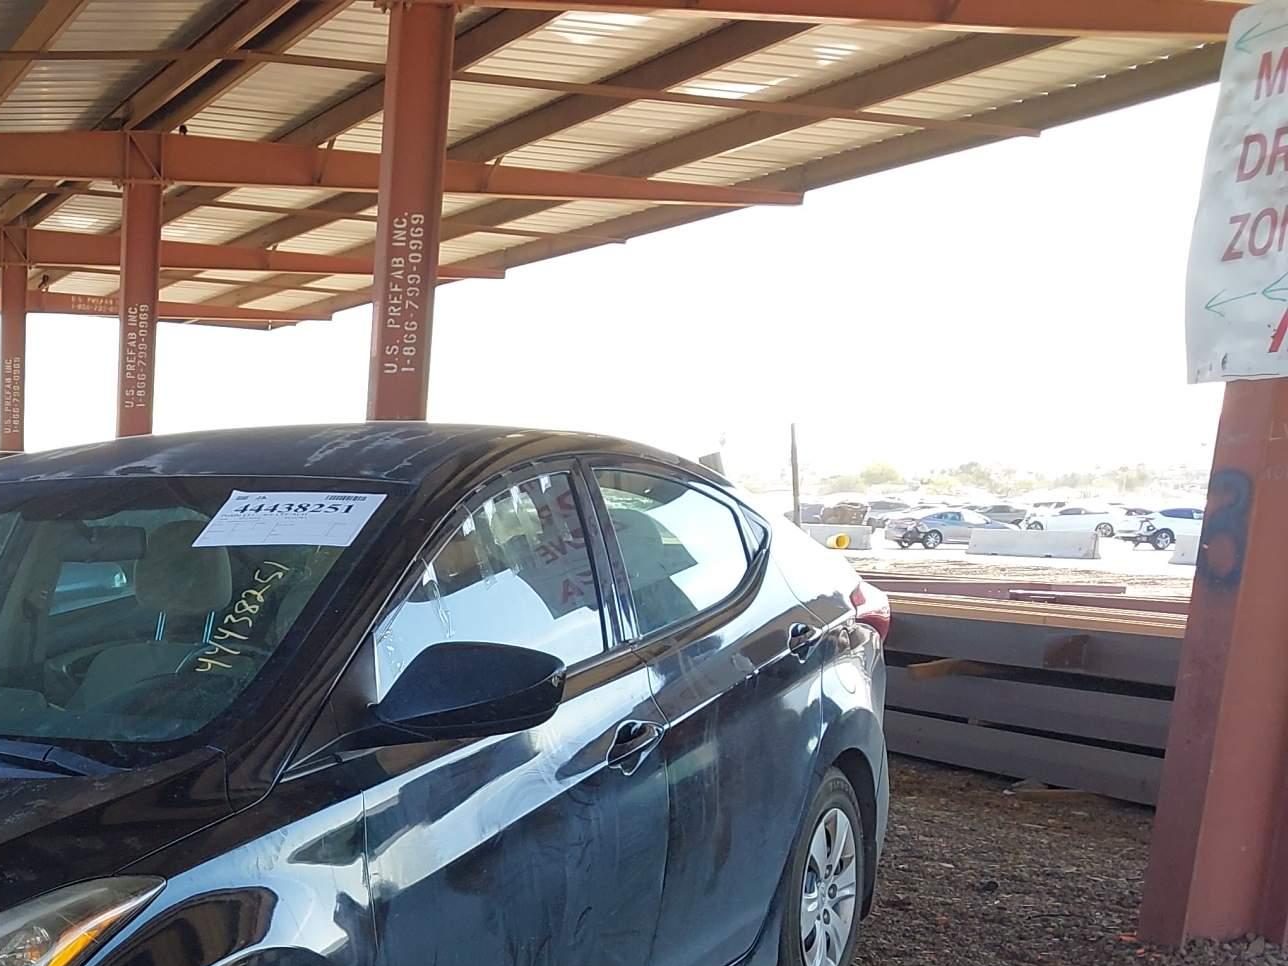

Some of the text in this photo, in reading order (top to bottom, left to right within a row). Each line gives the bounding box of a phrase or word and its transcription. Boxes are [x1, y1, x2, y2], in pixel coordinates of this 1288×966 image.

[384, 211, 409, 374] U.S. PREFAB INC.
[401, 213, 425, 372] 1-866-799-0969
[126, 332, 137, 379] PREFAB
[233, 503, 355, 515] 44438251
[195, 561, 290, 672] 44438251
